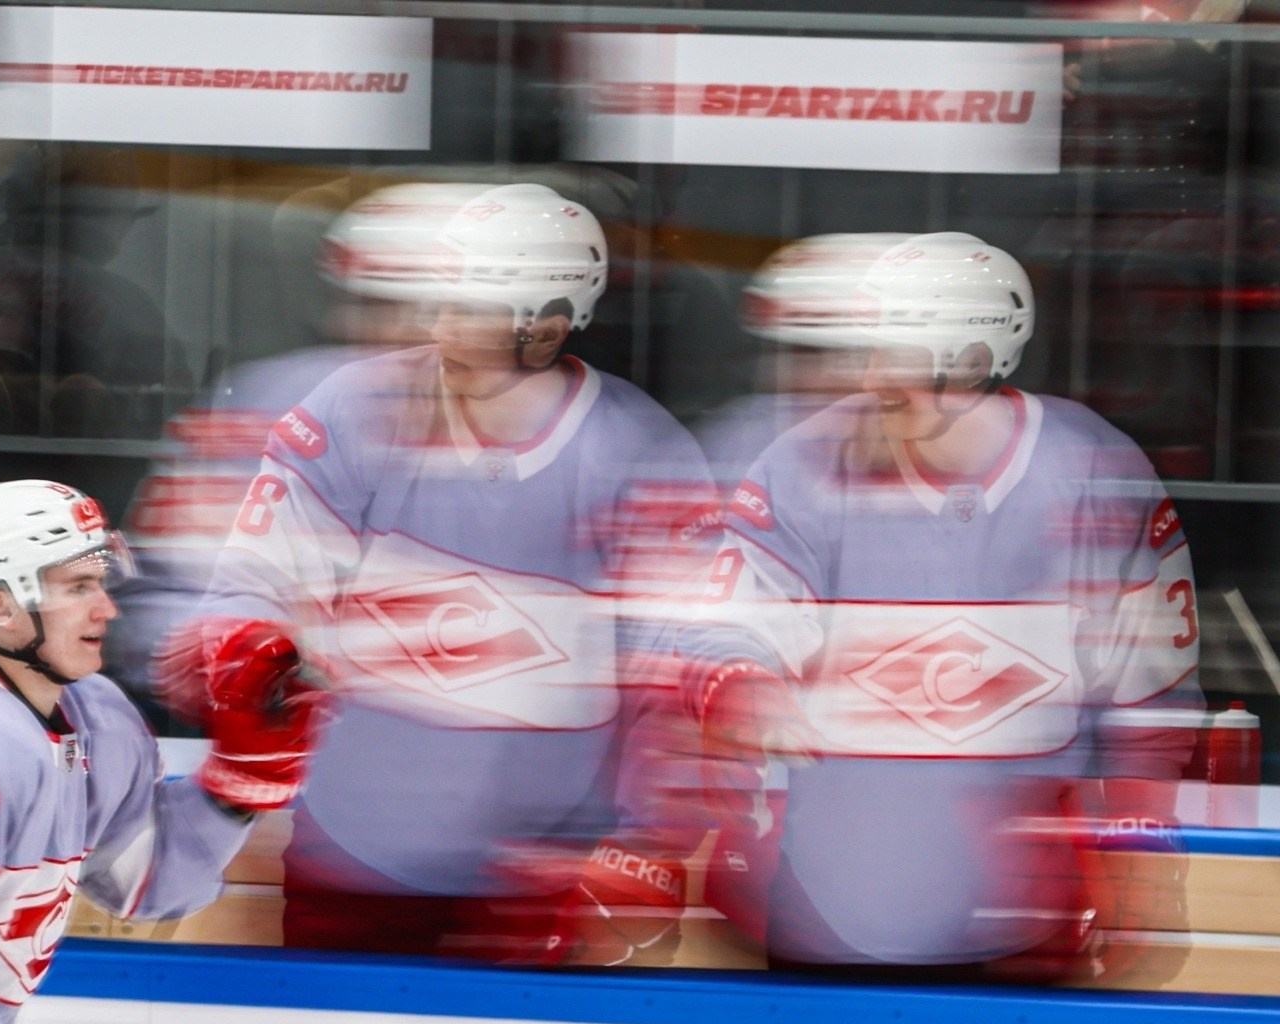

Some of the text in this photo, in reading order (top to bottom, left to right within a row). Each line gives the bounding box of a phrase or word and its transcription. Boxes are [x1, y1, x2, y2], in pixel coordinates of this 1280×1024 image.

[75, 63, 408, 93] TICKETS.SPARTAK.RU
[700, 84, 1035, 124] SPARTAK.RU
[549, 273, 586, 282] CCM
[969, 315, 1006, 326] CCM
[1166, 578, 1198, 649] 3
